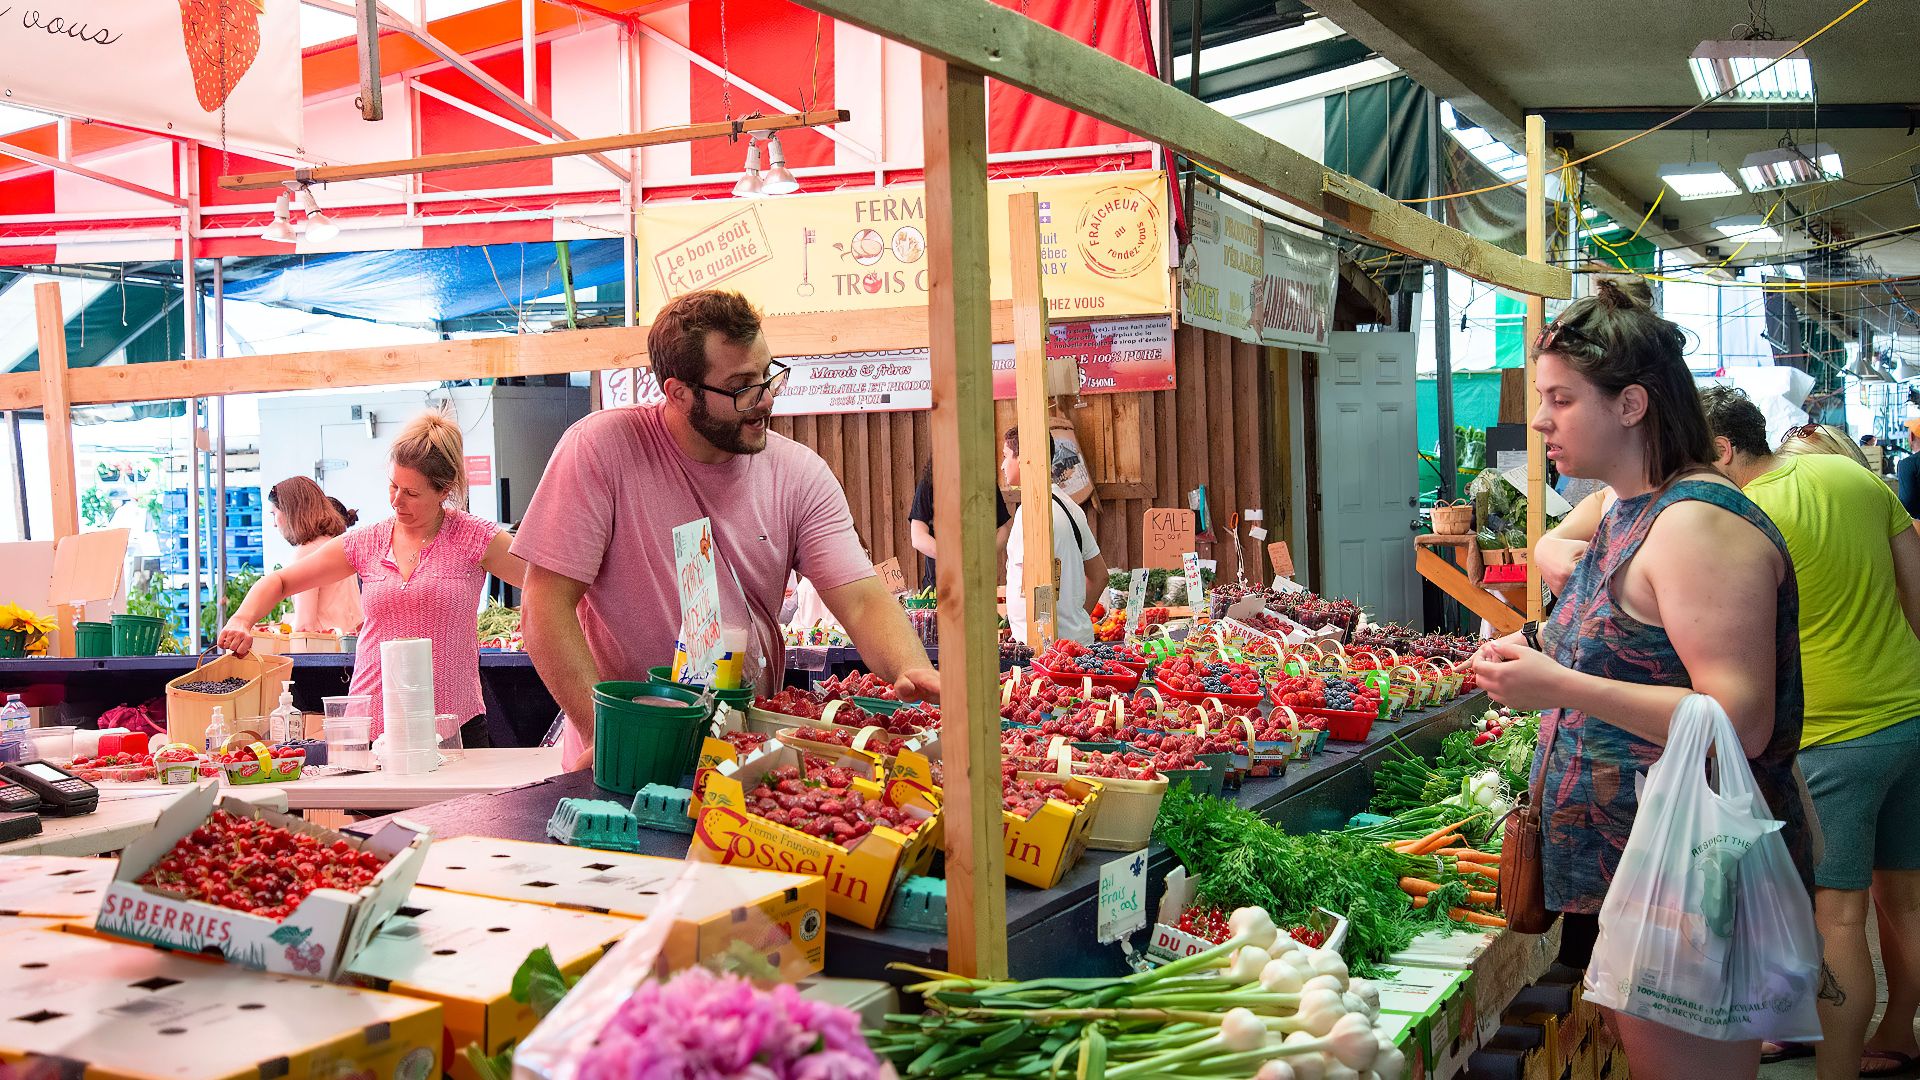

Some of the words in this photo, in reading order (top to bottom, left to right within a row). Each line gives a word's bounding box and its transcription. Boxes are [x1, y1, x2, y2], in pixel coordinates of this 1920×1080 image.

[22, 10, 123, 45] vous
[1088, 197, 1139, 247] FRAÎCHEUR
[1113, 225, 1127, 239] au
[667, 254, 685, 272] Le
[686, 240, 715, 262] bon
[717, 219, 751, 251] goût
[689, 267, 704, 284] la
[706, 237, 758, 278] qualité
[1074, 296, 1105, 309] VOUS
[1186, 281, 1223, 322] MIEL
[1093, 350, 1121, 364] 100%
[1123, 348, 1162, 362] PURE
[810, 365, 858, 380] Marois
[872, 363, 912, 380] frères
[1152, 511, 1190, 532] KALE
[748, 823, 778, 843] Ferme
[780, 832, 821, 858] François
[1731, 836, 1752, 850] THE
[1101, 872, 1114, 893] Ail
[1100, 886, 1126, 908] Frais
[103, 893, 233, 941] SPBERRIES
[1158, 932, 1181, 952] DU
